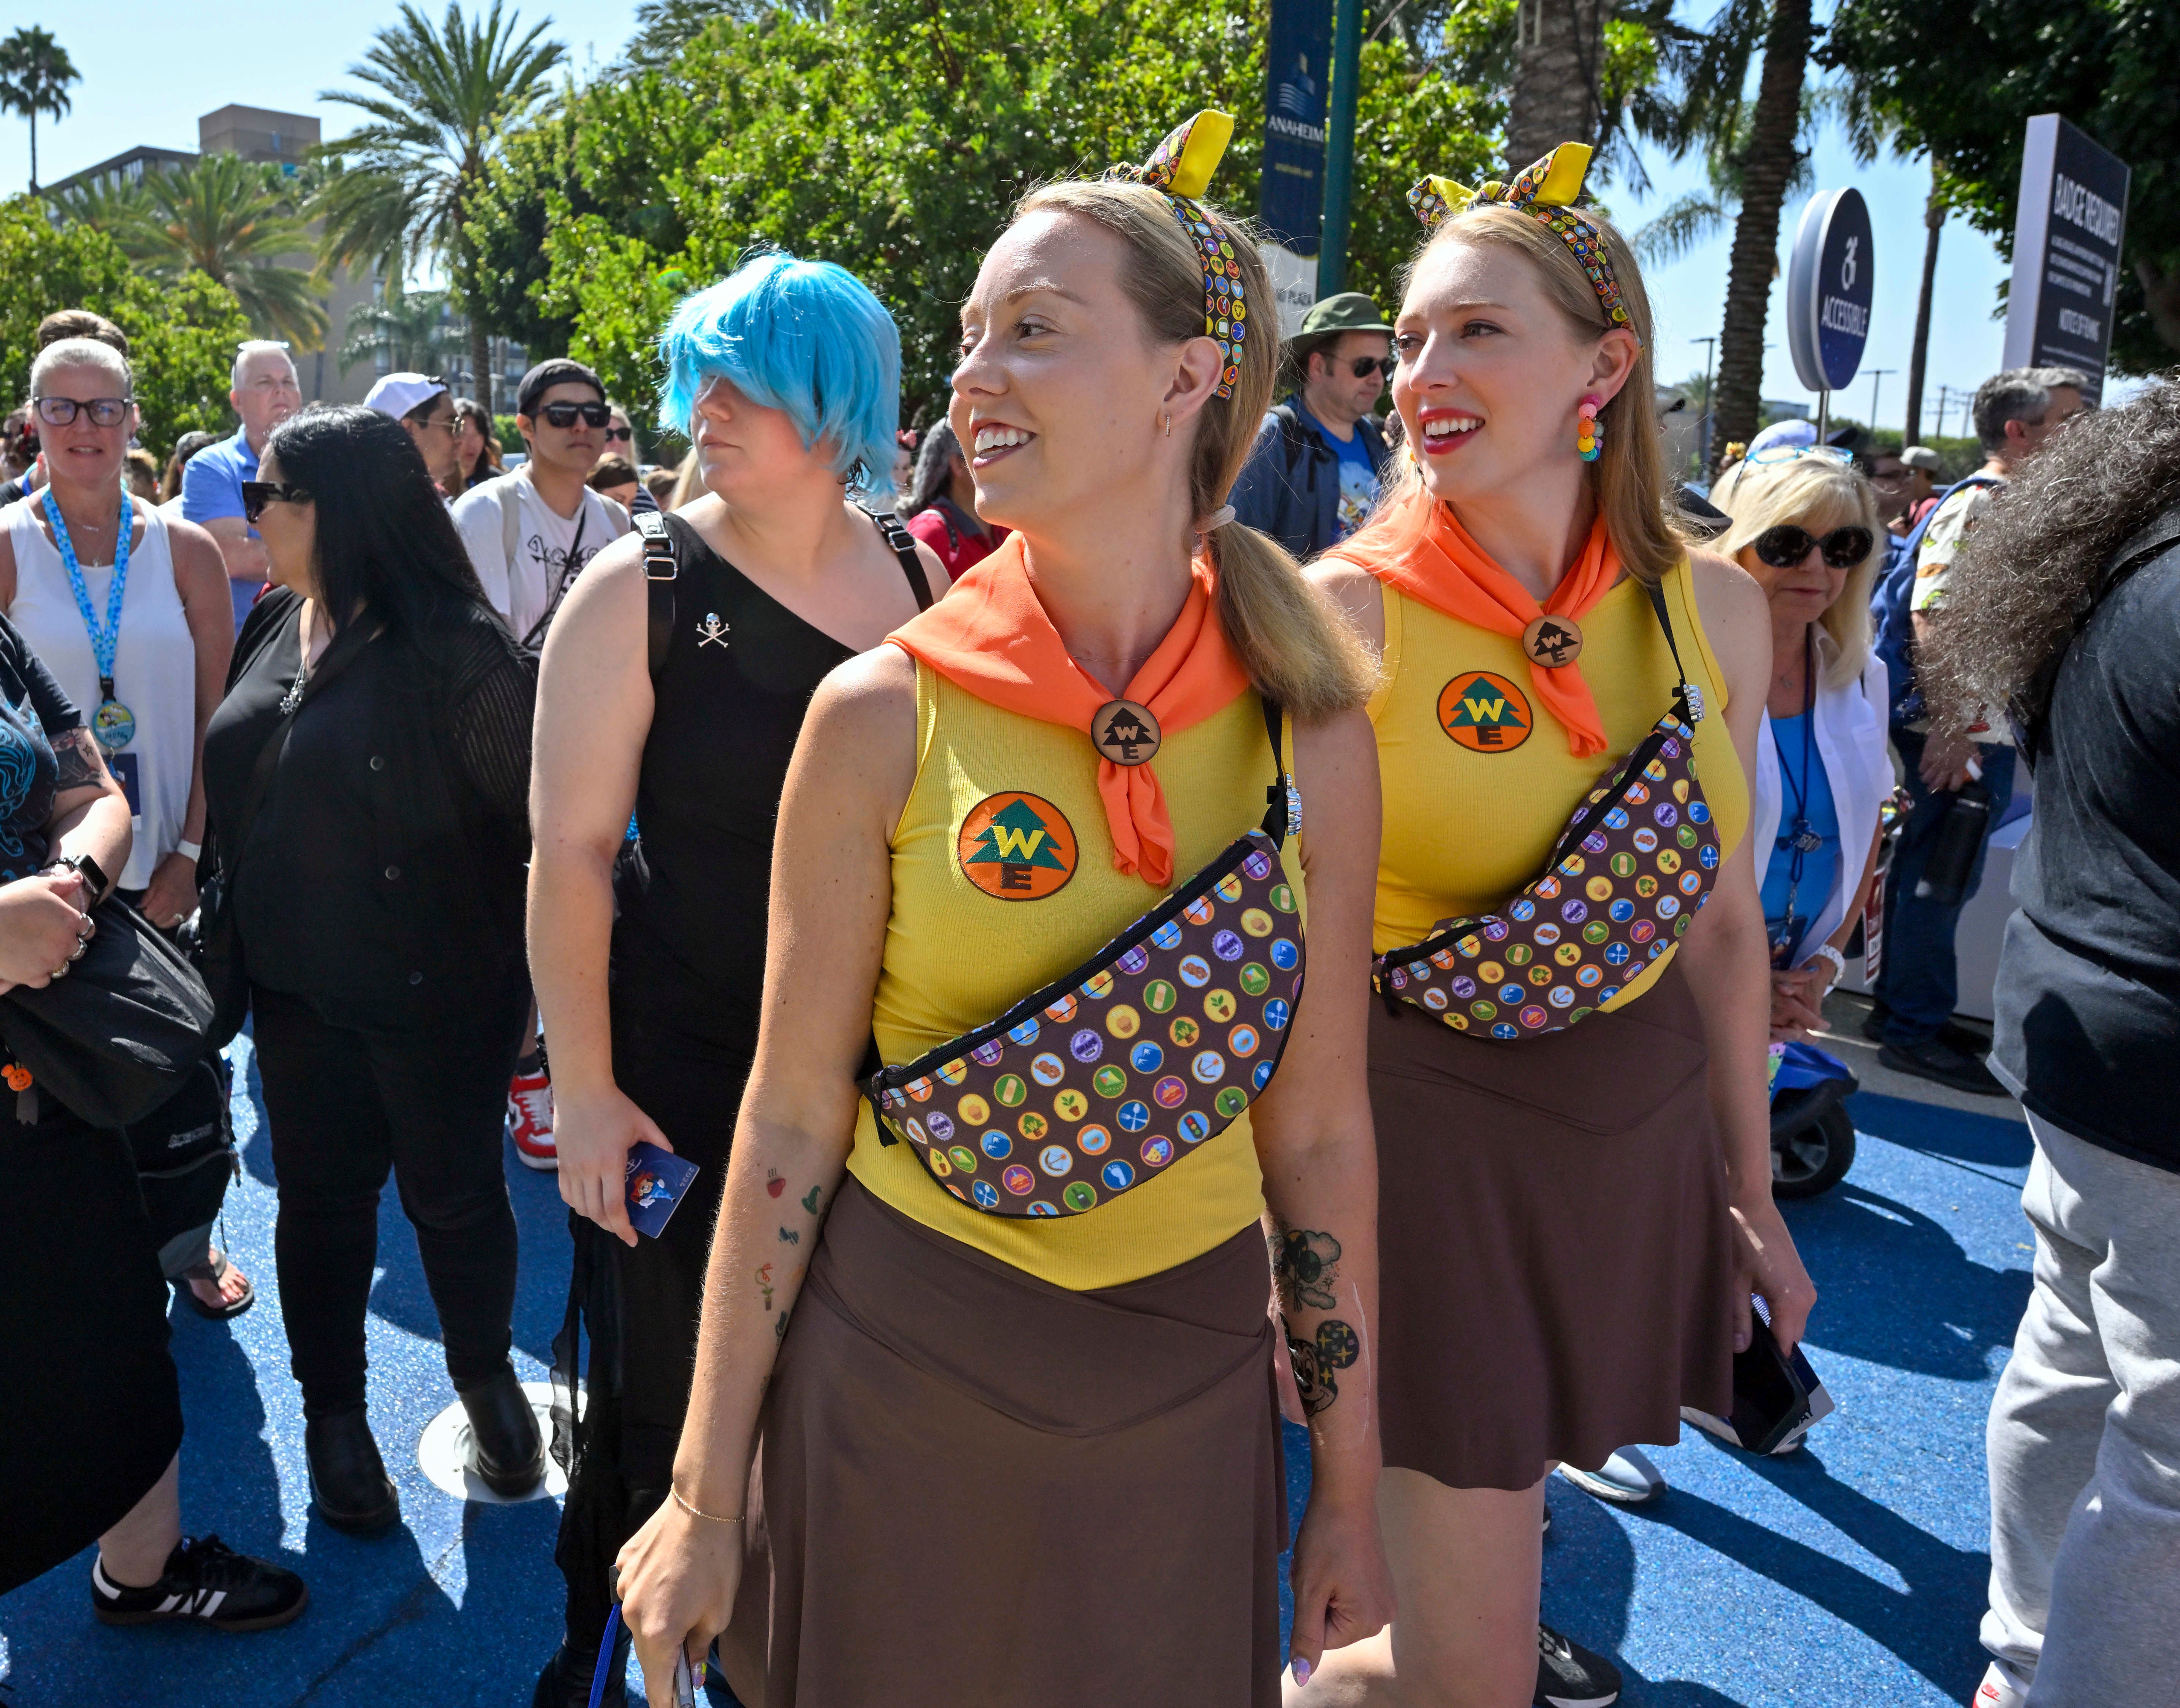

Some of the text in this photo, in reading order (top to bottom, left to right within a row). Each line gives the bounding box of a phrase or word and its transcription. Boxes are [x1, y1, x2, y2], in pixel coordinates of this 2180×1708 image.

[1268, 114, 1324, 143] ANAHEIM
[2054, 173, 2121, 247] BADGE REQUIRED
[1820, 294, 1868, 338] ACCESSIBLE
[1541, 633, 1562, 649] W
[1463, 698, 1505, 722] W
[1114, 725, 1139, 740] W
[1476, 725, 1503, 745] E
[1121, 743, 1139, 760] E
[991, 825, 1045, 860] W
[1000, 862, 1032, 890] E
[1076, 1037, 1097, 1055] GRAPE
